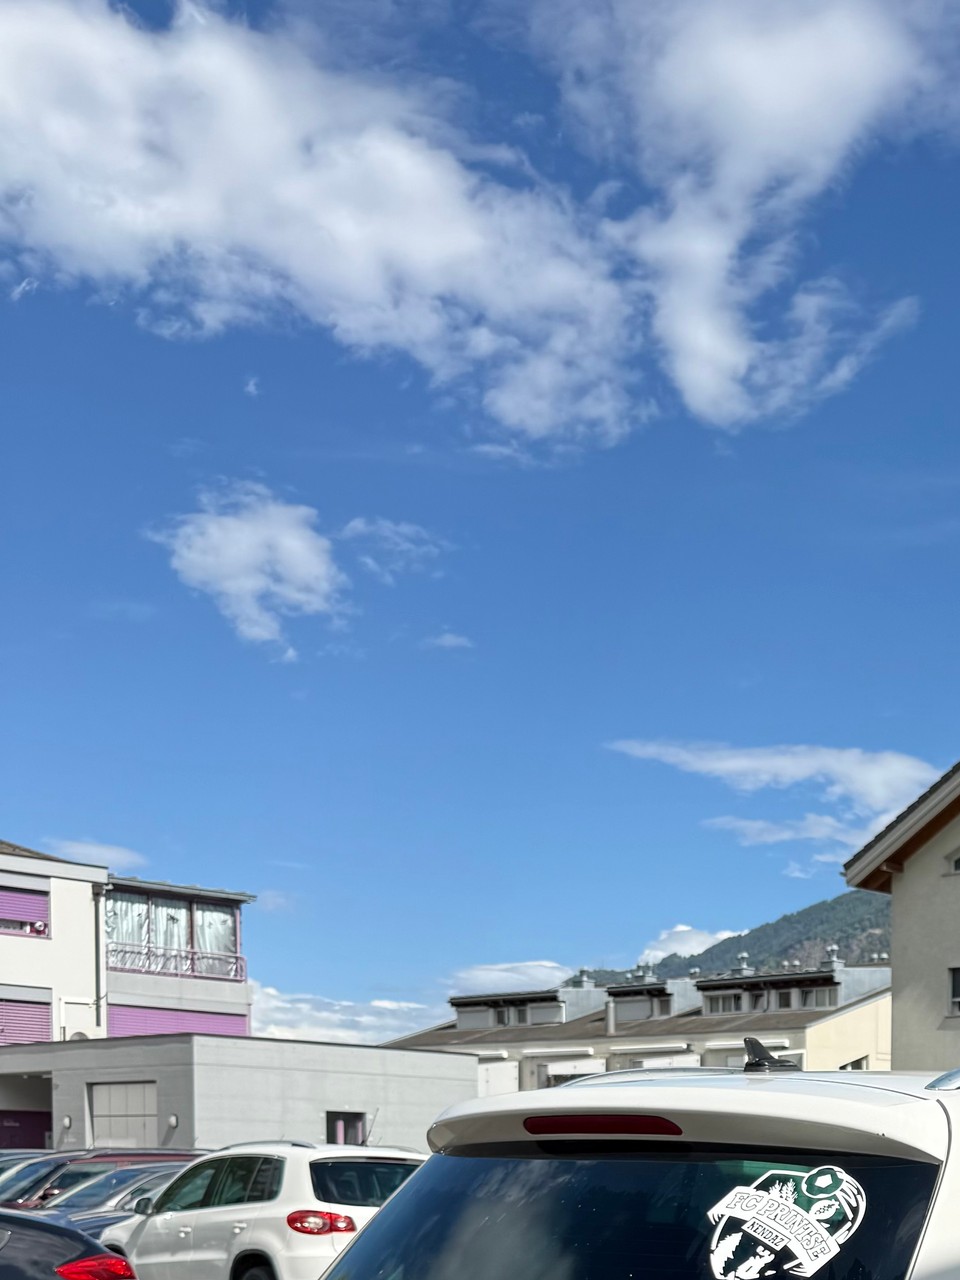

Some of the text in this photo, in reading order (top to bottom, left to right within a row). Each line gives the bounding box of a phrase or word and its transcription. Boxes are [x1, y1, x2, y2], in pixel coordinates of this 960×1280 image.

[725, 1192, 832, 1262] FC PRINTSE
[746, 1220, 786, 1248] NENDAZ
